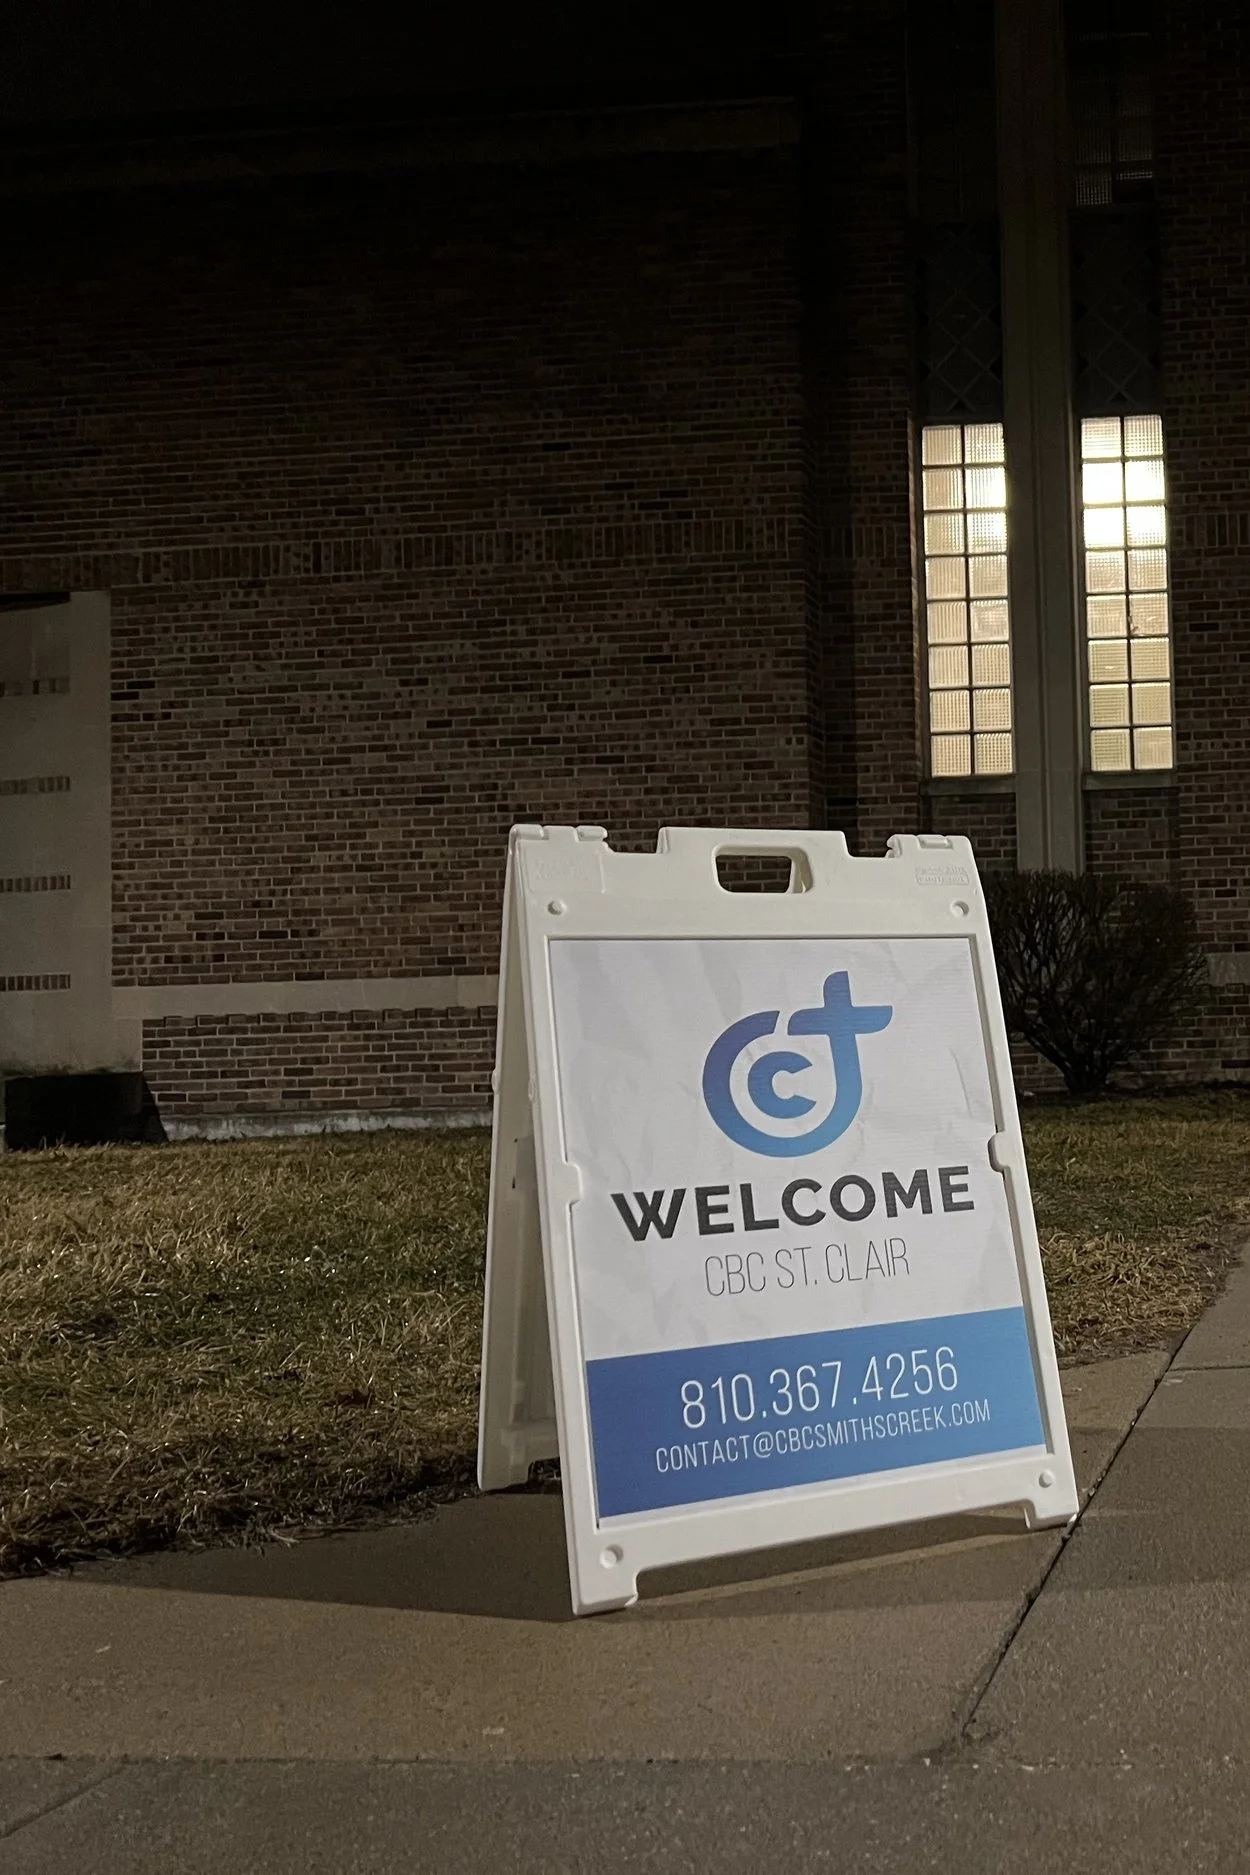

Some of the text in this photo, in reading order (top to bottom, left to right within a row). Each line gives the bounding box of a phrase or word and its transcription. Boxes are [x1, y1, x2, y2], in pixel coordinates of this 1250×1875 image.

[611, 1165, 975, 1242] WELCOME
[704, 1237, 911, 1297] CBC ST. CLAIR
[680, 1346, 959, 1430] 810.367.4256
[655, 1398, 992, 1474] CONTACT@CBCSMITHSCREEK.COM
